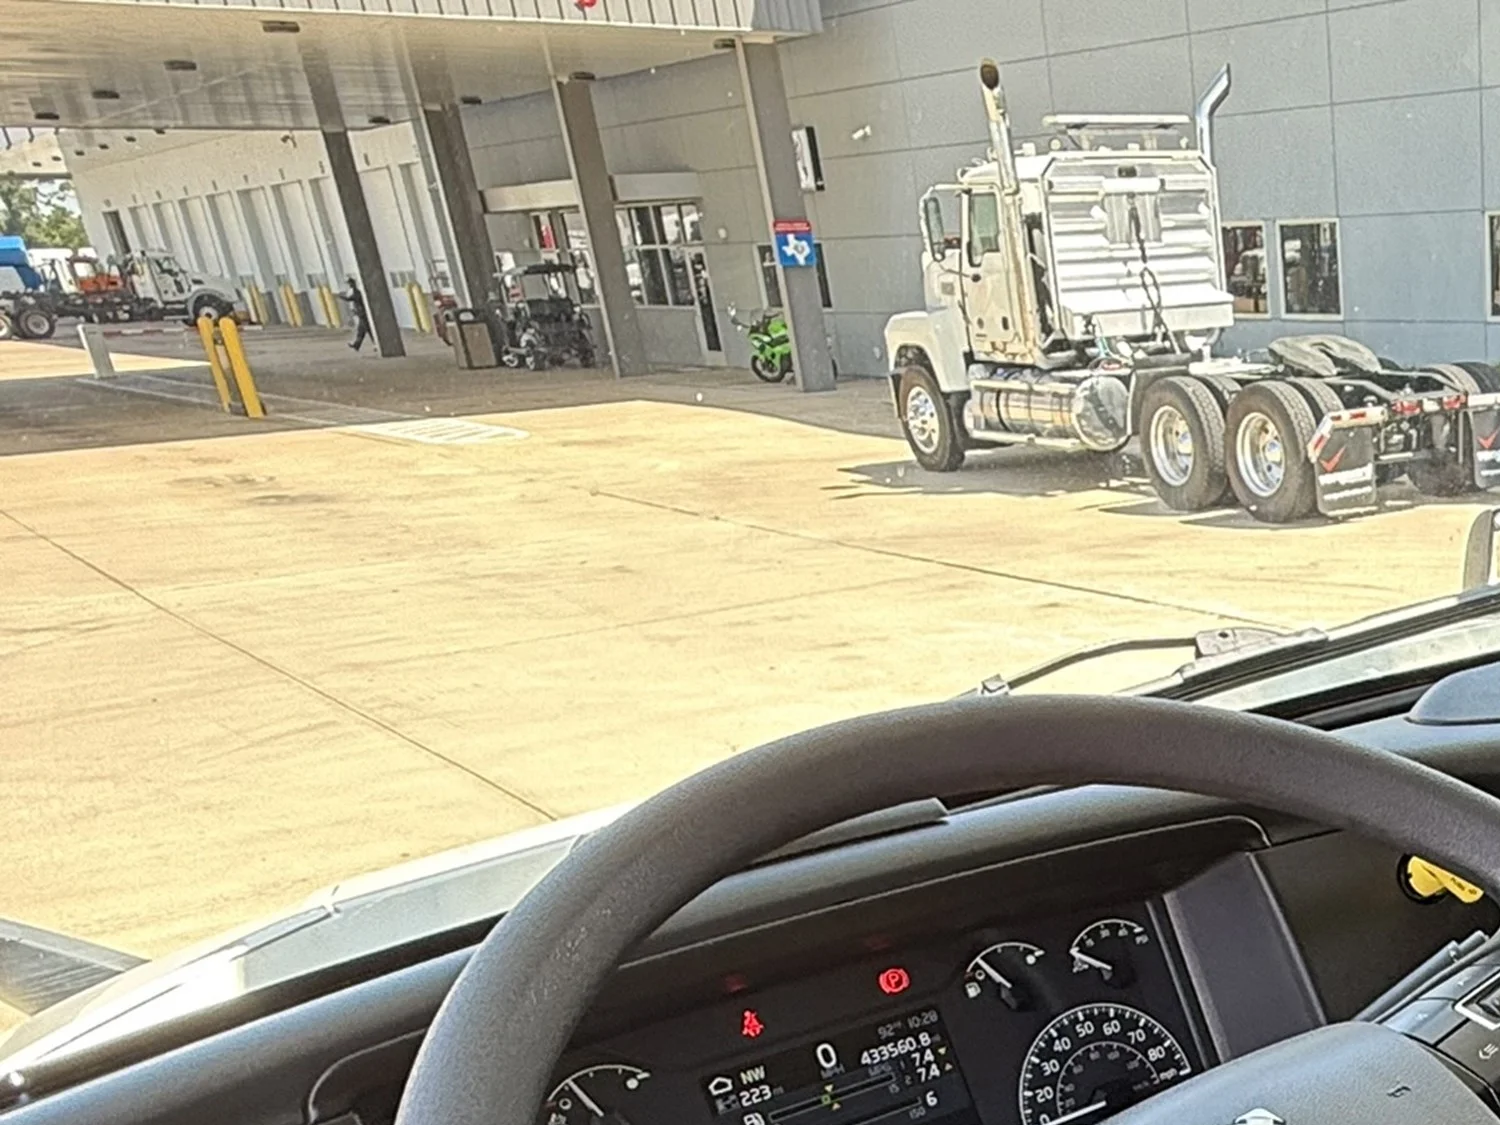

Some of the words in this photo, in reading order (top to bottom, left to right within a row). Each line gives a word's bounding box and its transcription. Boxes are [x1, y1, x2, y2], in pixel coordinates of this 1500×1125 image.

[907, 1009, 939, 1029] 10:28
[1102, 1019, 1121, 1036] 60
[1075, 1021, 1095, 1038] 50
[1127, 1029, 1147, 1044] 70
[860, 1031, 932, 1065] 433560.8
[1052, 1036, 1072, 1052] 40
[815, 1042, 838, 1069] 0
[1147, 1044, 1167, 1062] 80
[739, 1066, 766, 1085] NW
[1041, 1059, 1061, 1076] 30
[1159, 1067, 1178, 1081] mph
[739, 1084, 773, 1108] 223
[925, 1090, 938, 1107] 6
[1035, 1086, 1055, 1103] 20
